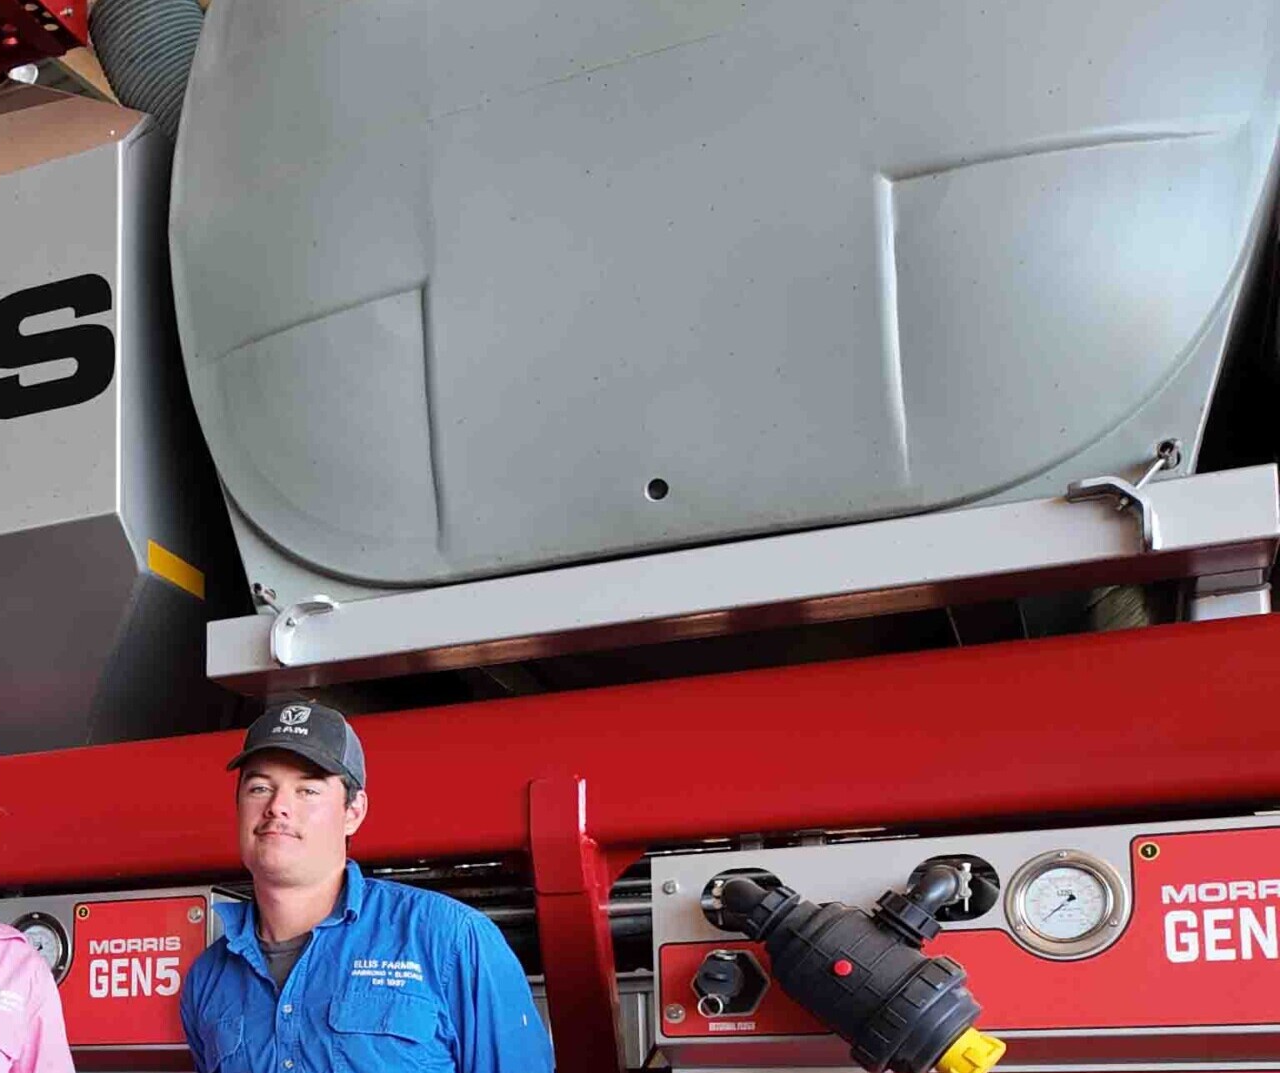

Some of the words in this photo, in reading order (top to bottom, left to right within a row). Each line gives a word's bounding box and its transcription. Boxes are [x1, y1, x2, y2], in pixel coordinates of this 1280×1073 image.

[271, 726, 309, 735] RAM
[1145, 846, 1152, 855] 1
[1164, 906, 1279, 964] GEN
[89, 936, 181, 955] MORRIS
[354, 959, 378, 969] ELLIS
[89, 957, 181, 998] GEN5
